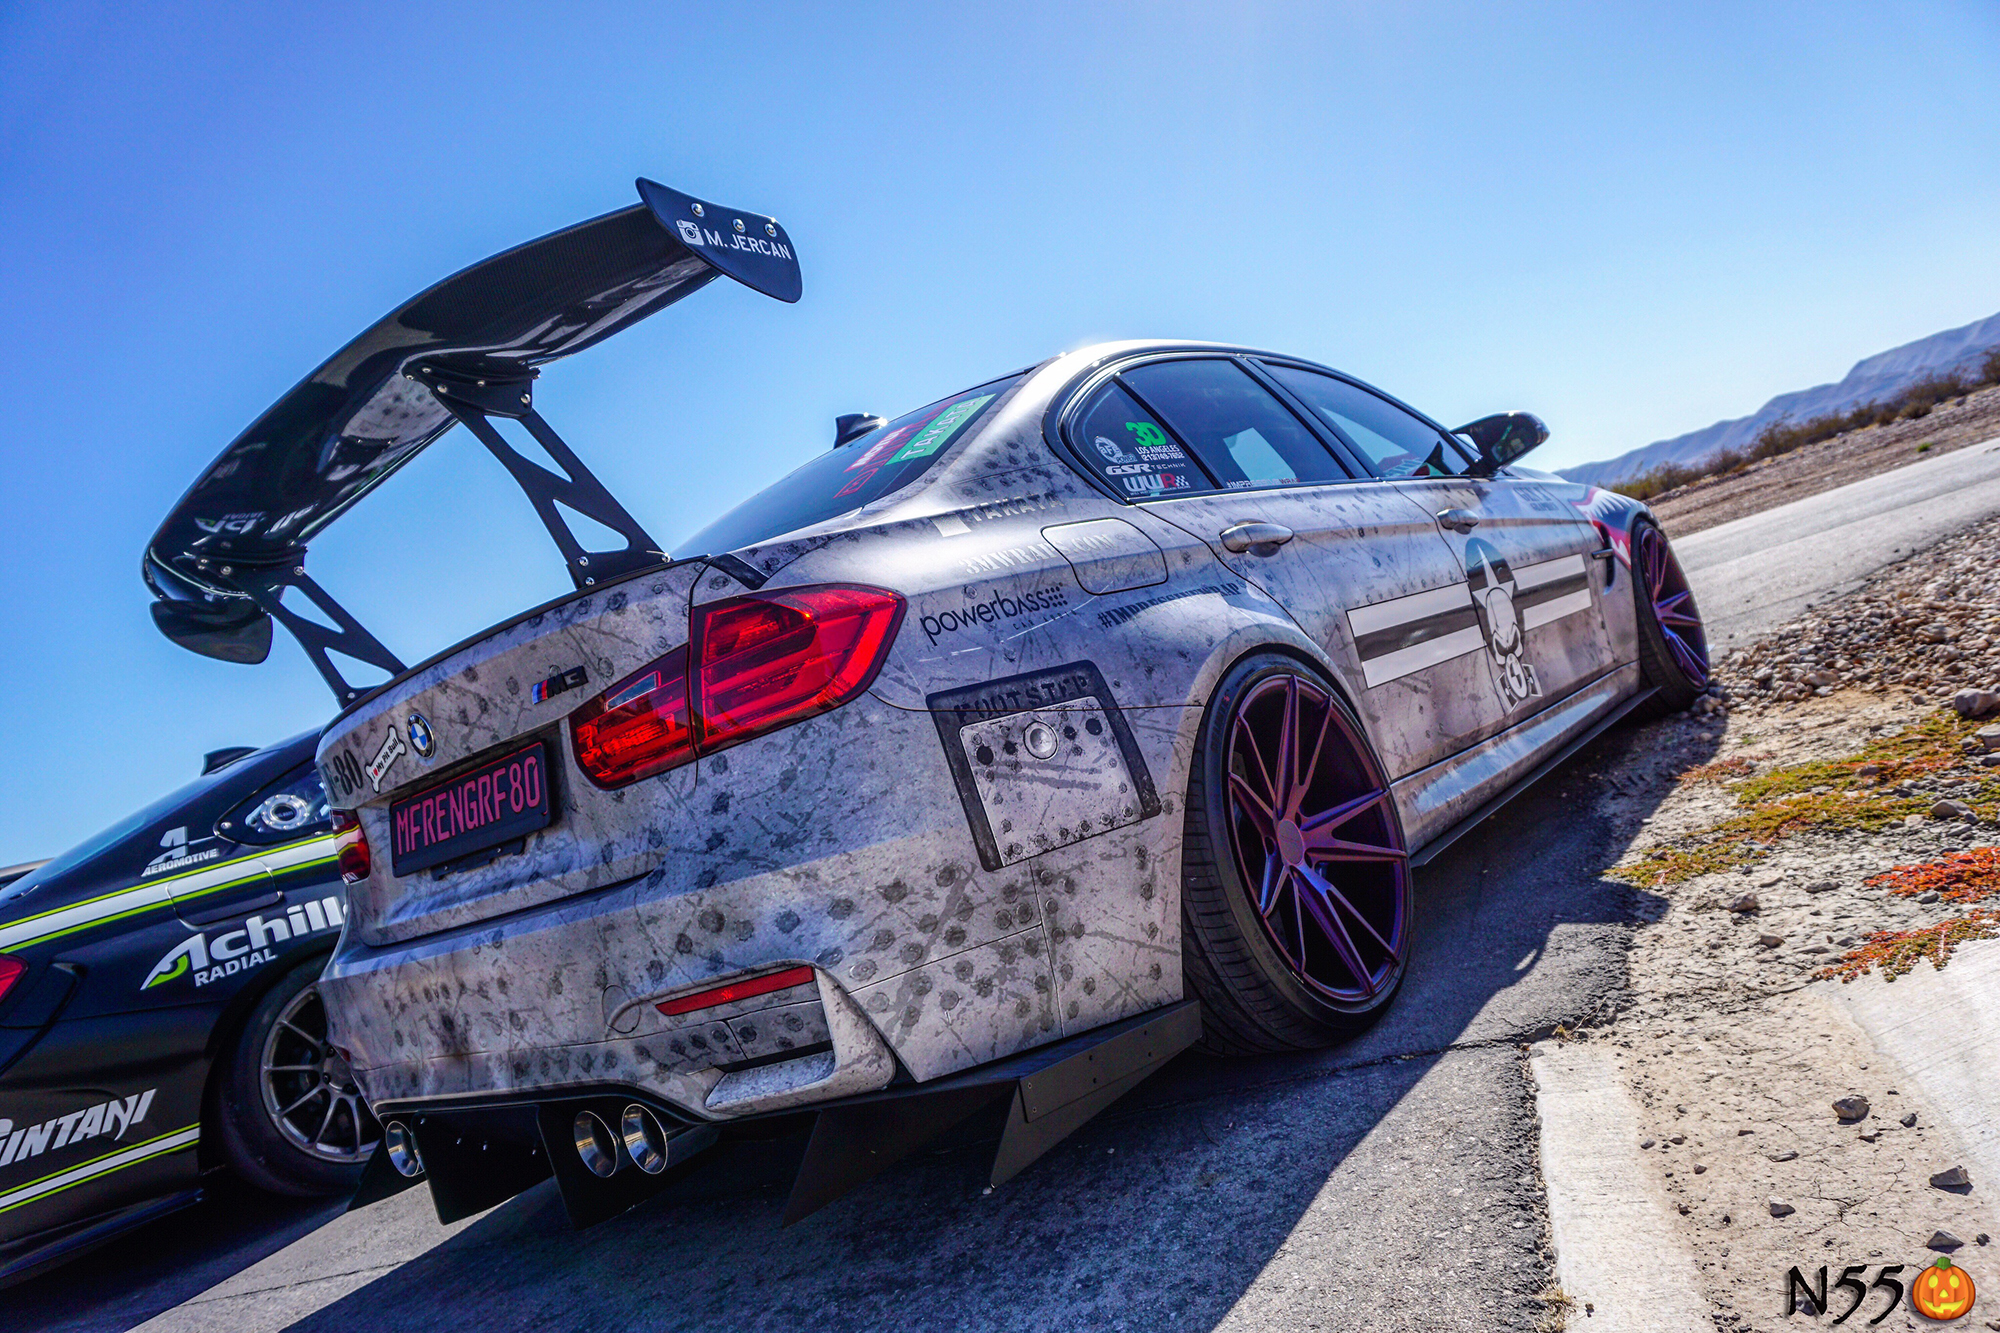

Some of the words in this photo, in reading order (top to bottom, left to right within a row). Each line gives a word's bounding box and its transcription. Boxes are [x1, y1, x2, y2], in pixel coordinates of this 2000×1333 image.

[703, 228, 728, 248] M.
[730, 233, 792, 260] JERCAN
[901, 398, 981, 461] TAKATA
[1125, 421, 1167, 447] 3D
[1135, 446, 1150, 455] LOS
[1149, 444, 1180, 454] ANGELES
[1151, 462, 1187, 470] TECHNIK
[1105, 463, 1152, 476] GSR
[546, 665, 589, 699] M3
[953, 690, 1021, 723] FOOT
[1025, 675, 1087, 707] STEP
[396, 755, 541, 856] MFRENGRF80
[140, 847, 220, 878] AEROMOTIVE
[139, 896, 349, 991] Achill
[194, 948, 278, 988] RADIAL
